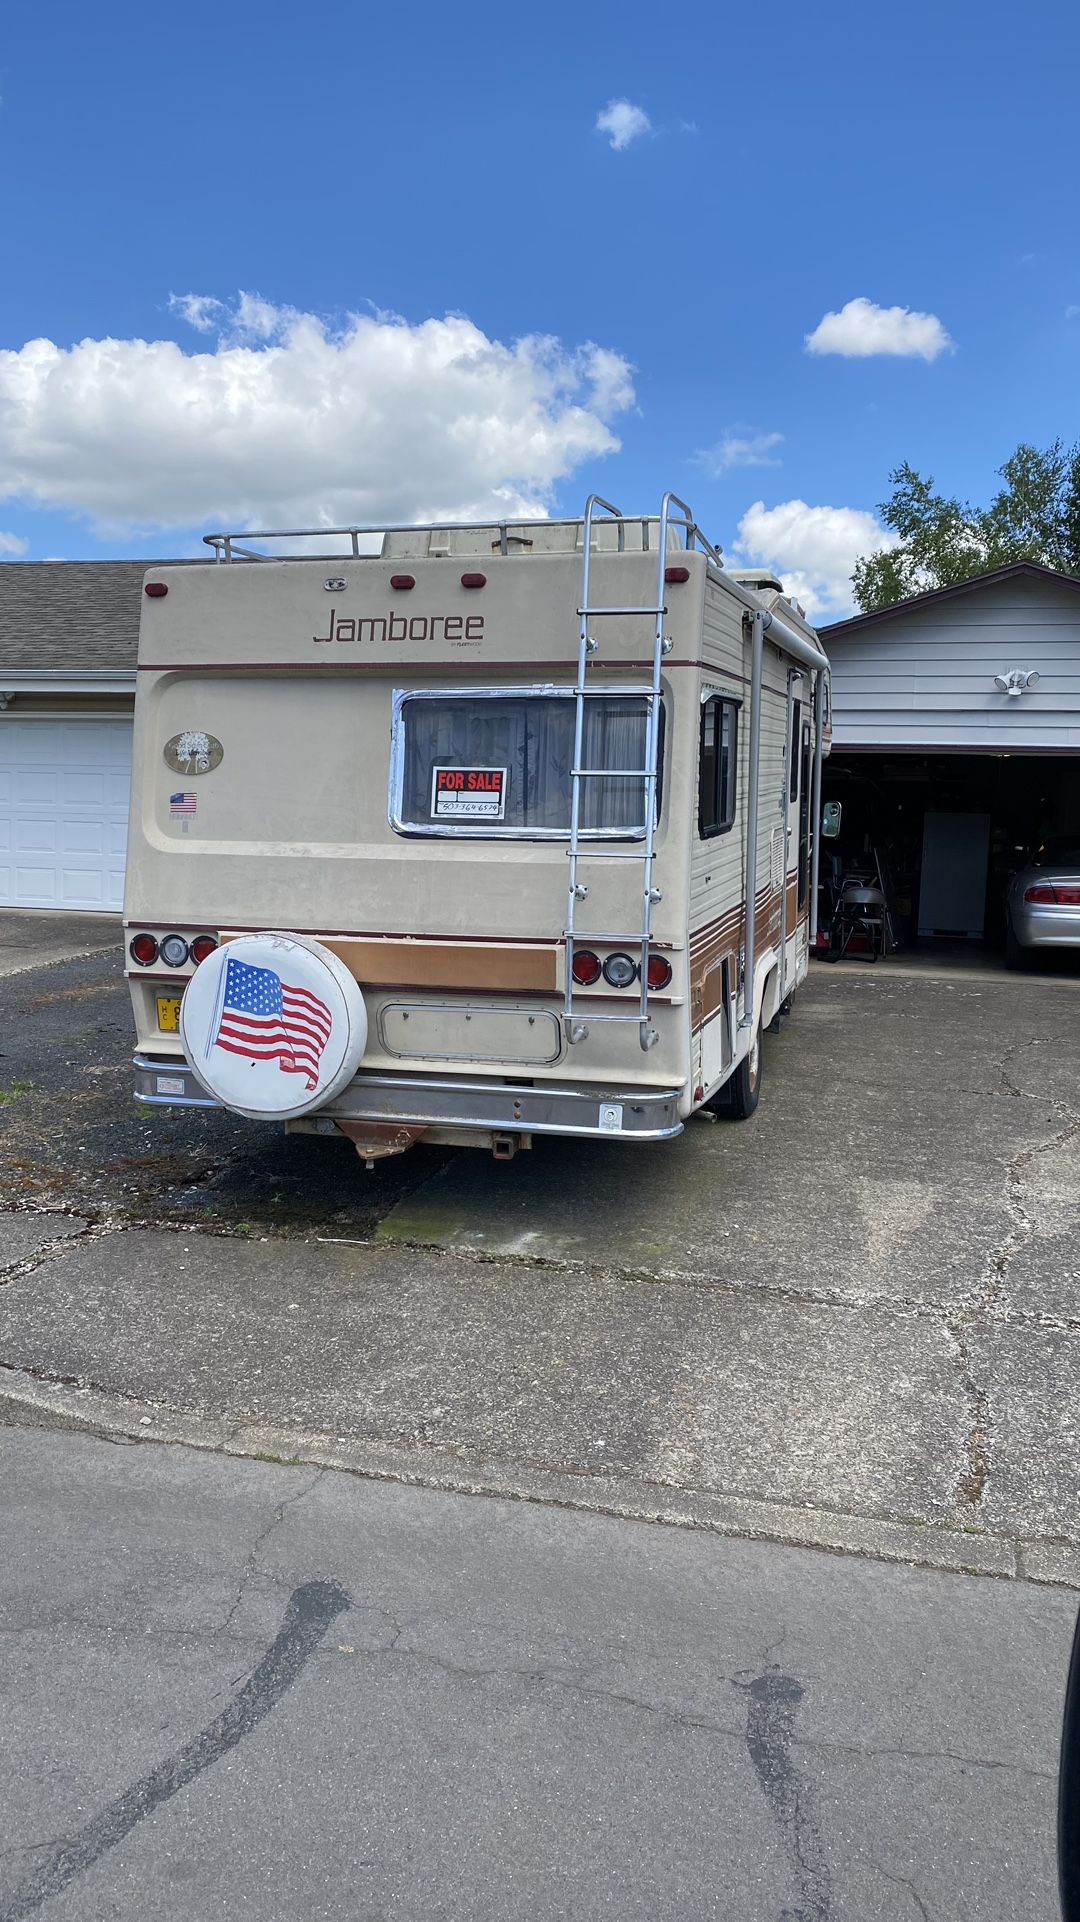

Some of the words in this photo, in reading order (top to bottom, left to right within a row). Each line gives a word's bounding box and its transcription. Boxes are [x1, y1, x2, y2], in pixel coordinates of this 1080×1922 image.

[313, 609, 485, 642] Jamboree
[438, 772, 464, 790] FOR
[467, 772, 501, 790] SALE
